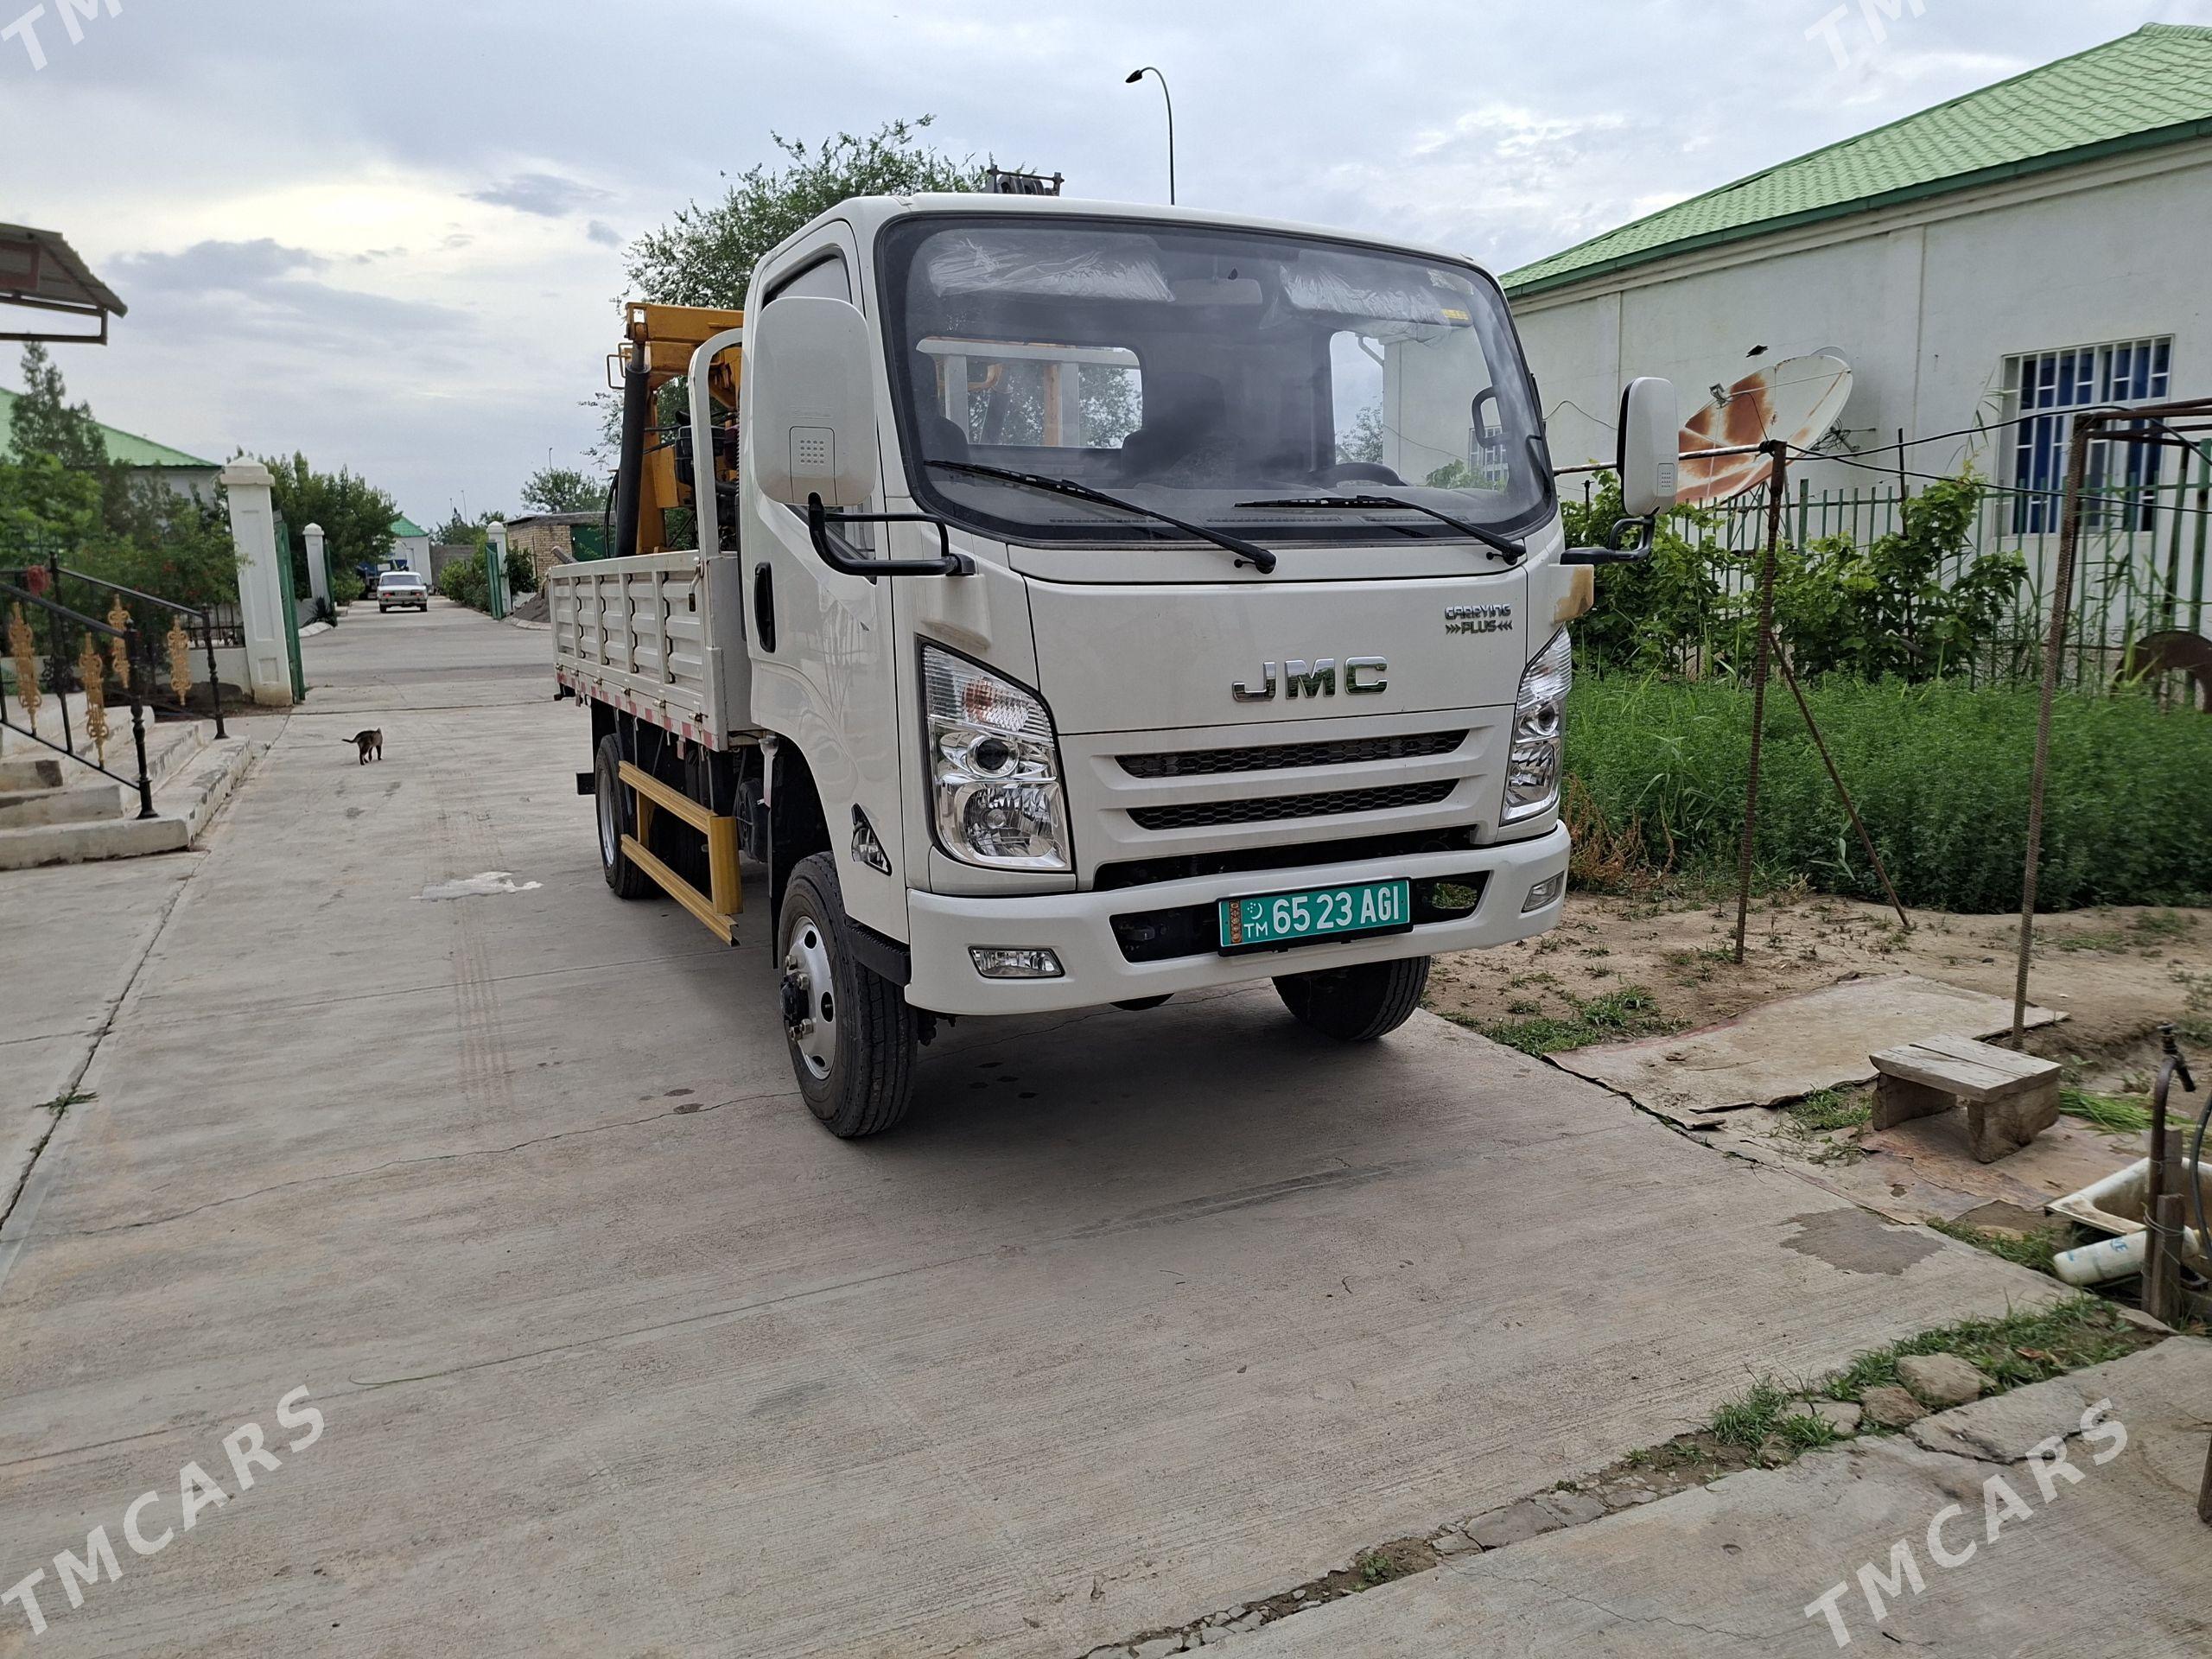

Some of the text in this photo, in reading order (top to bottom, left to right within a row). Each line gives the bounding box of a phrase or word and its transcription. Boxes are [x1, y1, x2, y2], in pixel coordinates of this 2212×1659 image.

[1445, 603, 1512, 620] CARRYING
[1461, 620, 1497, 634] PLUS
[1232, 656, 1388, 702] JMC
[1243, 921, 1268, 938] TM
